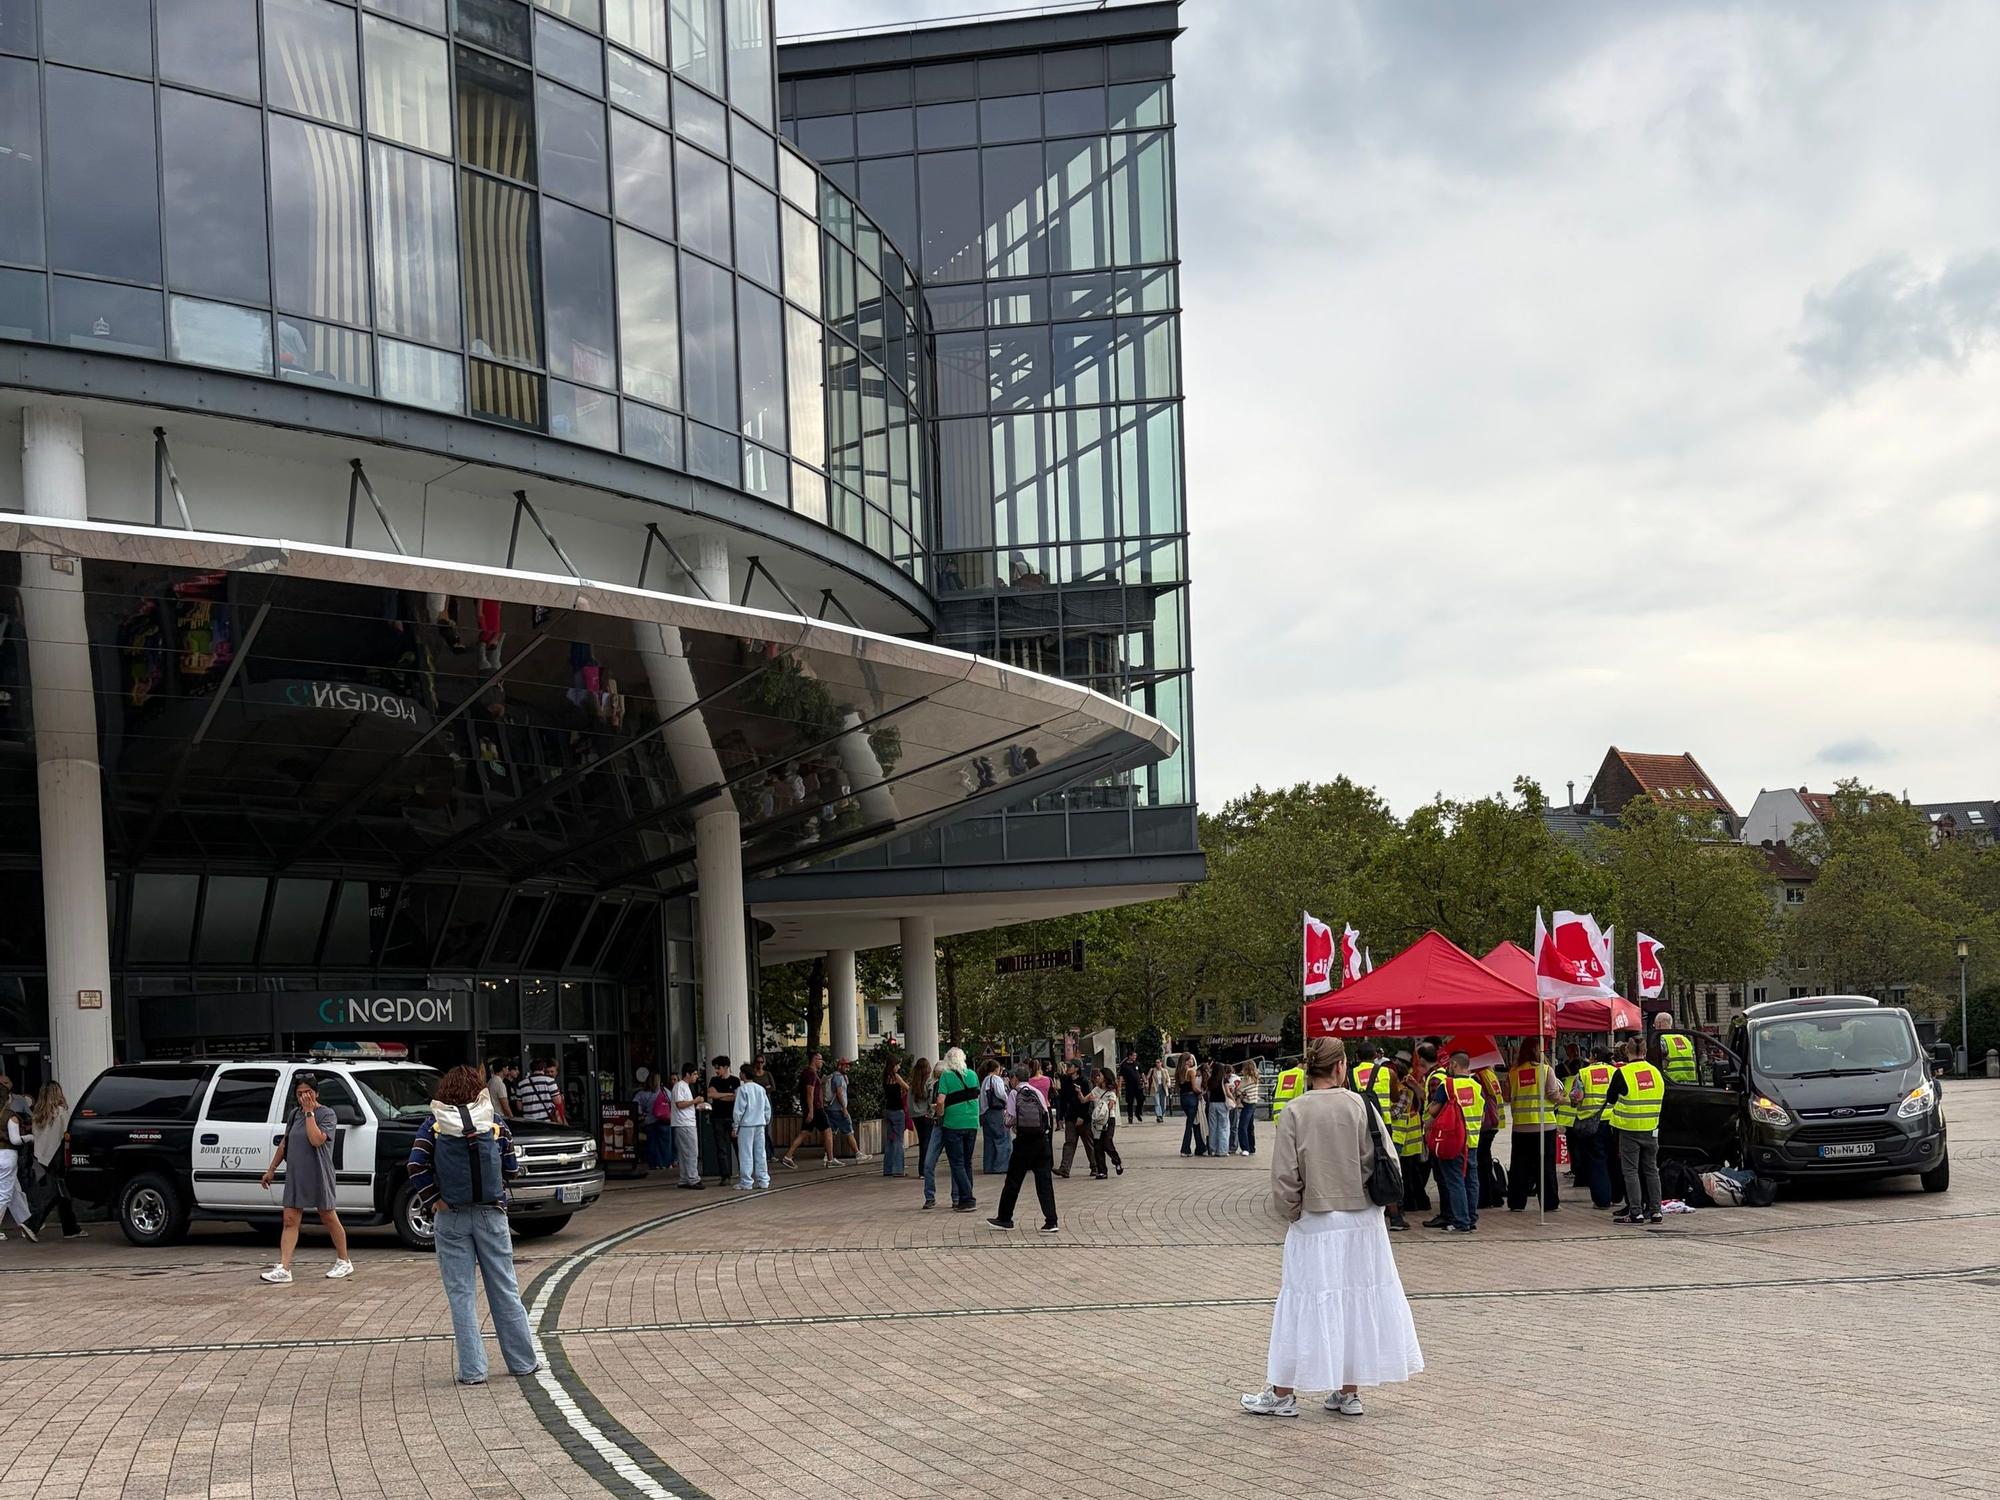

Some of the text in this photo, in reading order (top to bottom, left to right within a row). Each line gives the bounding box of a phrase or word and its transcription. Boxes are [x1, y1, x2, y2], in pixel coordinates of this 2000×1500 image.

[200, 1146, 261, 1154] BOMB DETECTION
[1824, 1144, 1874, 1155] BN NW 102
[221, 1155, 242, 1169] K-9
